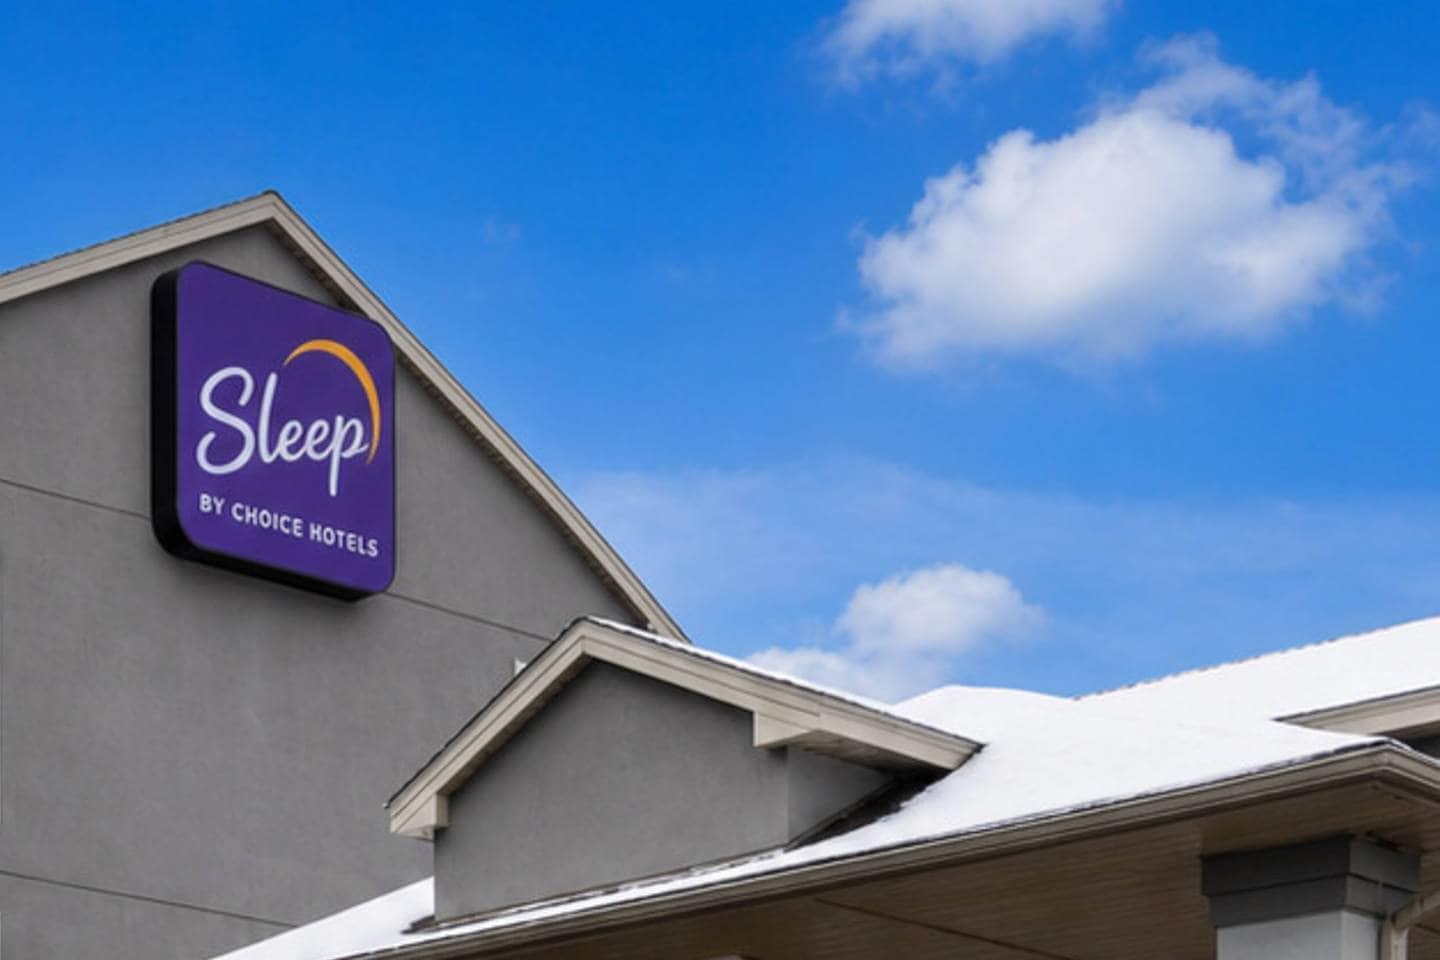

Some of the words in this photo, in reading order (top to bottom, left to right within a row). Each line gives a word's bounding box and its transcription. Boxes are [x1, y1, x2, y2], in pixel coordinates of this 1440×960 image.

[196, 366, 369, 497] Sleep
[199, 493, 225, 515] BY
[231, 502, 303, 537] CHOICE
[309, 523, 378, 557] HOTELS
